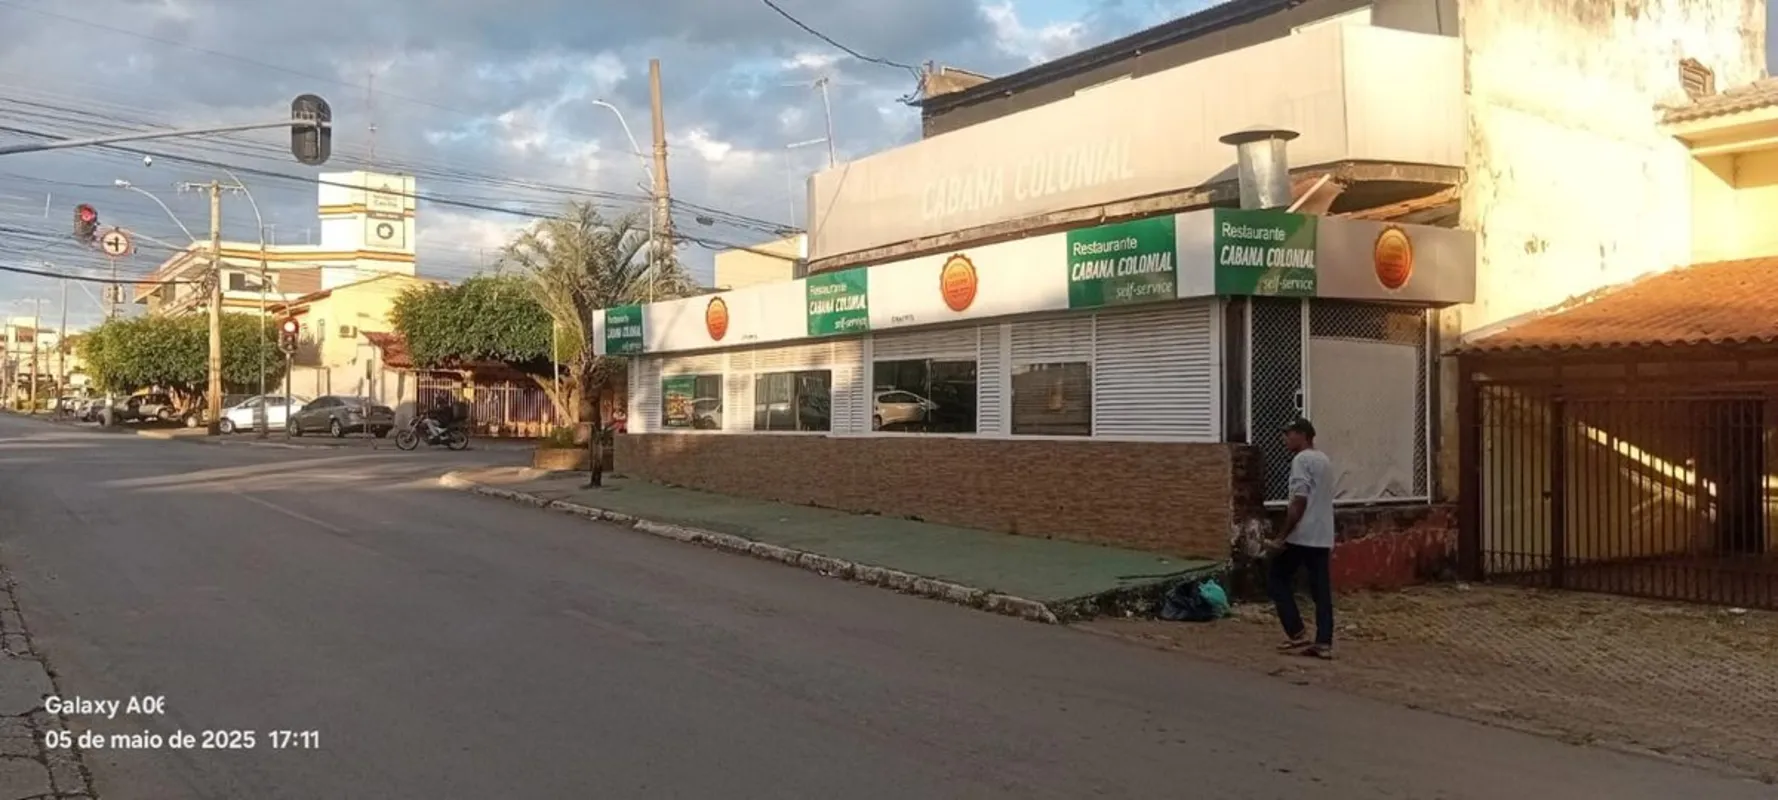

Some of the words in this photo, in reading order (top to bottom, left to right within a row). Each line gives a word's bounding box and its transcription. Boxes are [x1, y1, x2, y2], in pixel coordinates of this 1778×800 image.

[922, 166, 1004, 220] CABANA
[1014, 136, 1134, 201] COLONIAL
[1222, 222, 1286, 241] Restaurante
[1073, 237, 1138, 256] Restaurante
[1072, 259, 1115, 281] CABANA
[1117, 252, 1173, 277] COLONIAL
[1220, 245, 1264, 267] CABANA
[1266, 247, 1315, 269] COLONIAL
[1116, 281, 1173, 300] self-service
[1261, 275, 1314, 293] self-service
